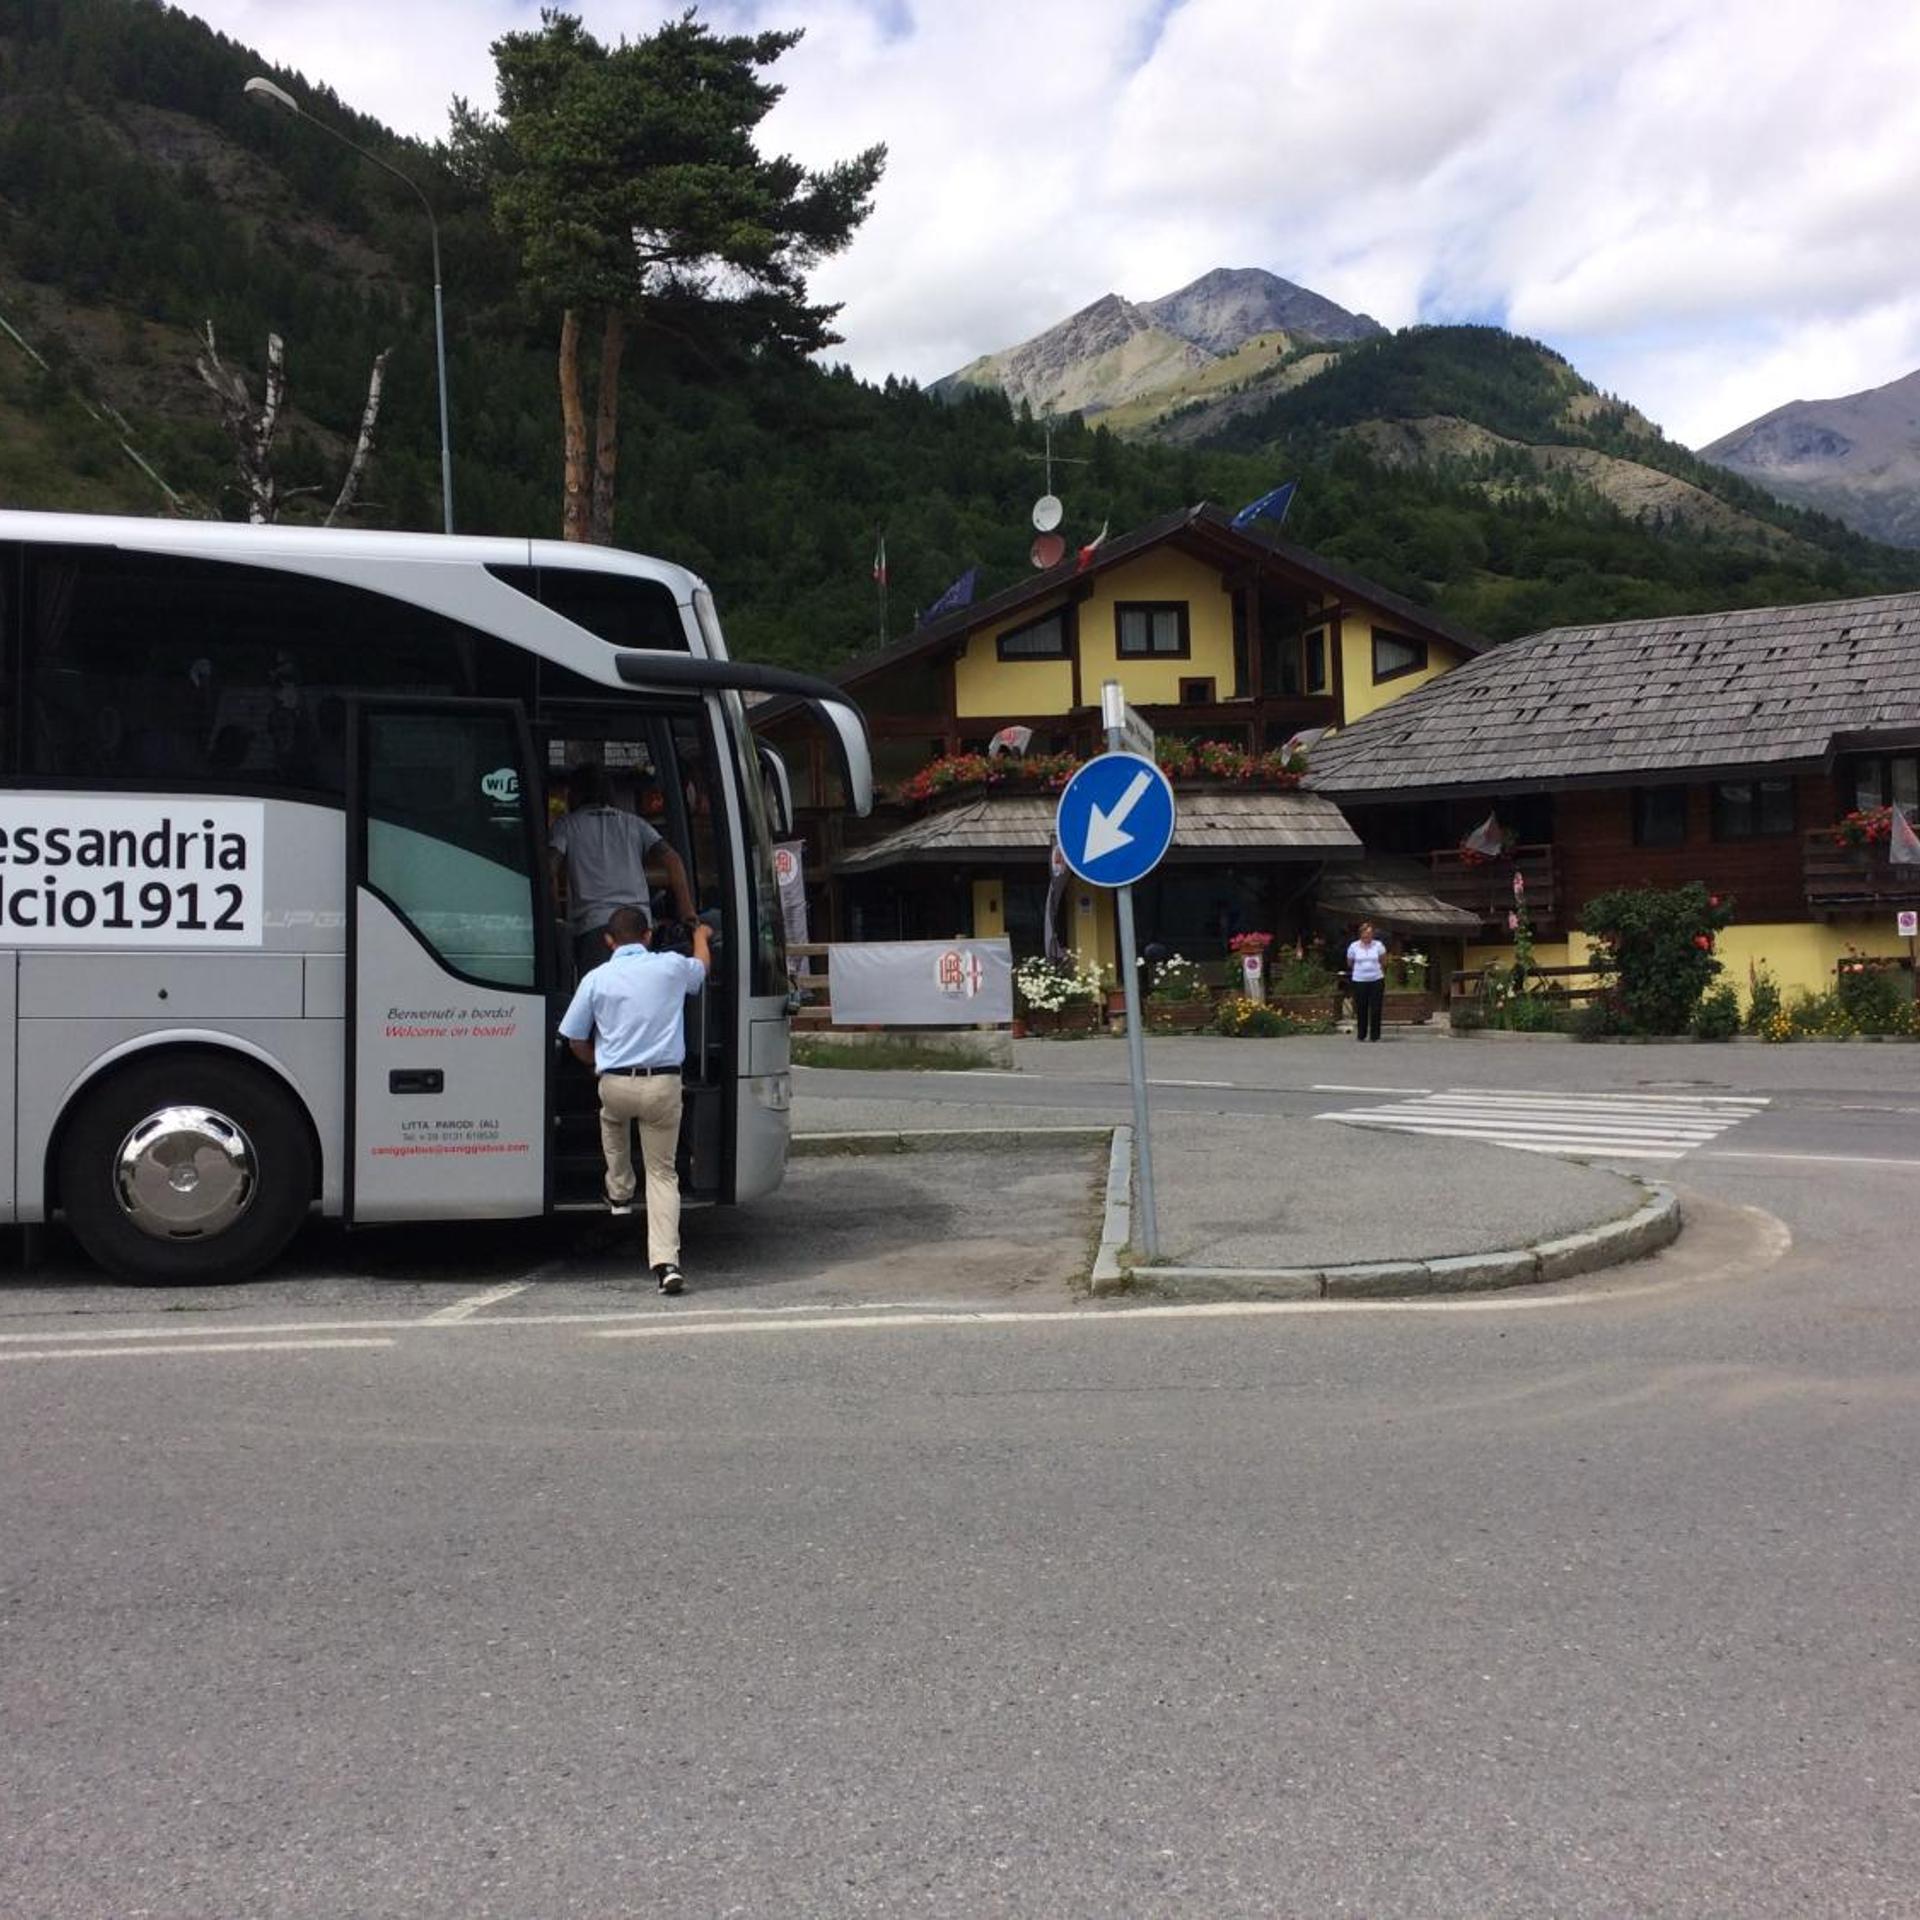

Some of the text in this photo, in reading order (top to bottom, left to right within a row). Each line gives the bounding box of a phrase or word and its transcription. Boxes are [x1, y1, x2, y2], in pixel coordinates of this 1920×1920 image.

[0, 818, 247, 871] ssandria
[387, 1007, 516, 1020] Benvenuti a bordo!
[386, 1024, 516, 1037] Welcome on board!
[401, 1118, 500, 1130] LITTA PARODI (AL)
